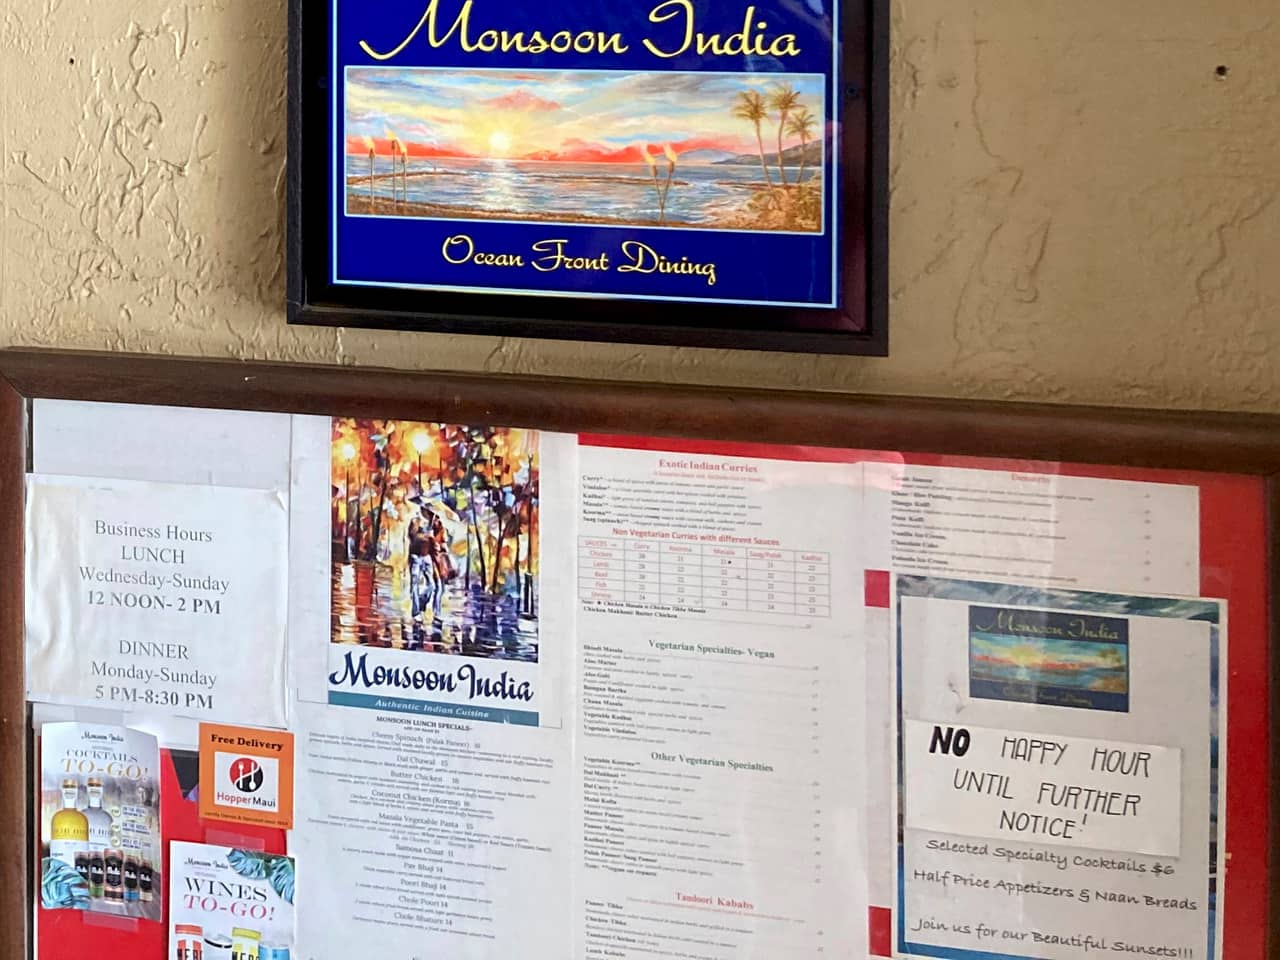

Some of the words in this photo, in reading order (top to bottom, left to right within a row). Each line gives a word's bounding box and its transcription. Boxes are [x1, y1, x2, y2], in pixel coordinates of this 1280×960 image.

[442, 234, 524, 266] Ocean
[531, 240, 609, 272] Front
[618, 241, 716, 286] Dining
[659, 459, 688, 469] Exotic
[689, 462, 720, 471] Indian
[721, 464, 758, 473] Curries
[95, 520, 160, 538] Business
[167, 525, 212, 542] Hours
[613, 528, 627, 536] Non
[630, 529, 669, 541] Vegetarian
[672, 532, 697, 541] Curries
[700, 534, 716, 542] with
[719, 535, 751, 544] different
[122, 545, 185, 564] LUNCH
[80, 566, 229, 594] Wednesday-Sunday
[88, 591, 104, 604] 12
[110, 592, 172, 609] NOON-
[178, 598, 186, 611] 2
[193, 598, 221, 614] PM
[1068, 619, 1119, 639] India
[120, 640, 189, 659] DINNER
[649, 640, 695, 652] Vegetarian
[747, 648, 775, 658] Vegan
[91, 661, 217, 689] Monday-Sunday
[328, 651, 457, 692] Monsoon
[458, 664, 534, 702] India
[95, 685, 103, 699] 5
[110, 686, 178, 706] PM-8:30
[185, 693, 213, 709] PM
[375, 699, 420, 711] Authentic
[424, 705, 453, 715] Indian
[456, 708, 489, 718] Cuisine
[377, 716, 411, 724] MONSOON
[413, 718, 436, 728] LUNCH
[211, 734, 235, 744] Free
[238, 737, 283, 751] Delivery
[929, 726, 970, 757] NO
[1001, 736, 1068, 765] HAPPY
[1091, 746, 1151, 778] HOUR
[67, 750, 138, 762] COCKTAILS
[651, 752, 676, 762] Other
[679, 755, 725, 767] Vegetarian
[728, 760, 774, 772] Specialties
[61, 758, 148, 781] TO-GO!
[953, 768, 1014, 799] UNTIL
[1037, 782, 1142, 817] FURTHER
[926, 839, 988, 856] Selected
[993, 847, 1068, 870] Specialty
[1073, 855, 1147, 873] Cocktails
[1151, 863, 1175, 875] $6
[185, 877, 267, 902] WINES
[677, 892, 713, 904] Tandoori
[717, 897, 754, 910] Kababs
[913, 869, 950, 885] Half
[953, 874, 990, 889] Price
[993, 878, 1074, 898] Appetizers
[1096, 891, 1139, 904] Naan
[1144, 895, 1197, 910] Breads
[184, 895, 274, 920] TO-GO!
[910, 918, 948, 932] Join
[953, 923, 971, 935] us
[976, 923, 996, 939] for
[1002, 929, 1027, 939] our
[1032, 931, 1107, 952] Beautiful
[1111, 941, 1193, 958] Sunsets!!!
